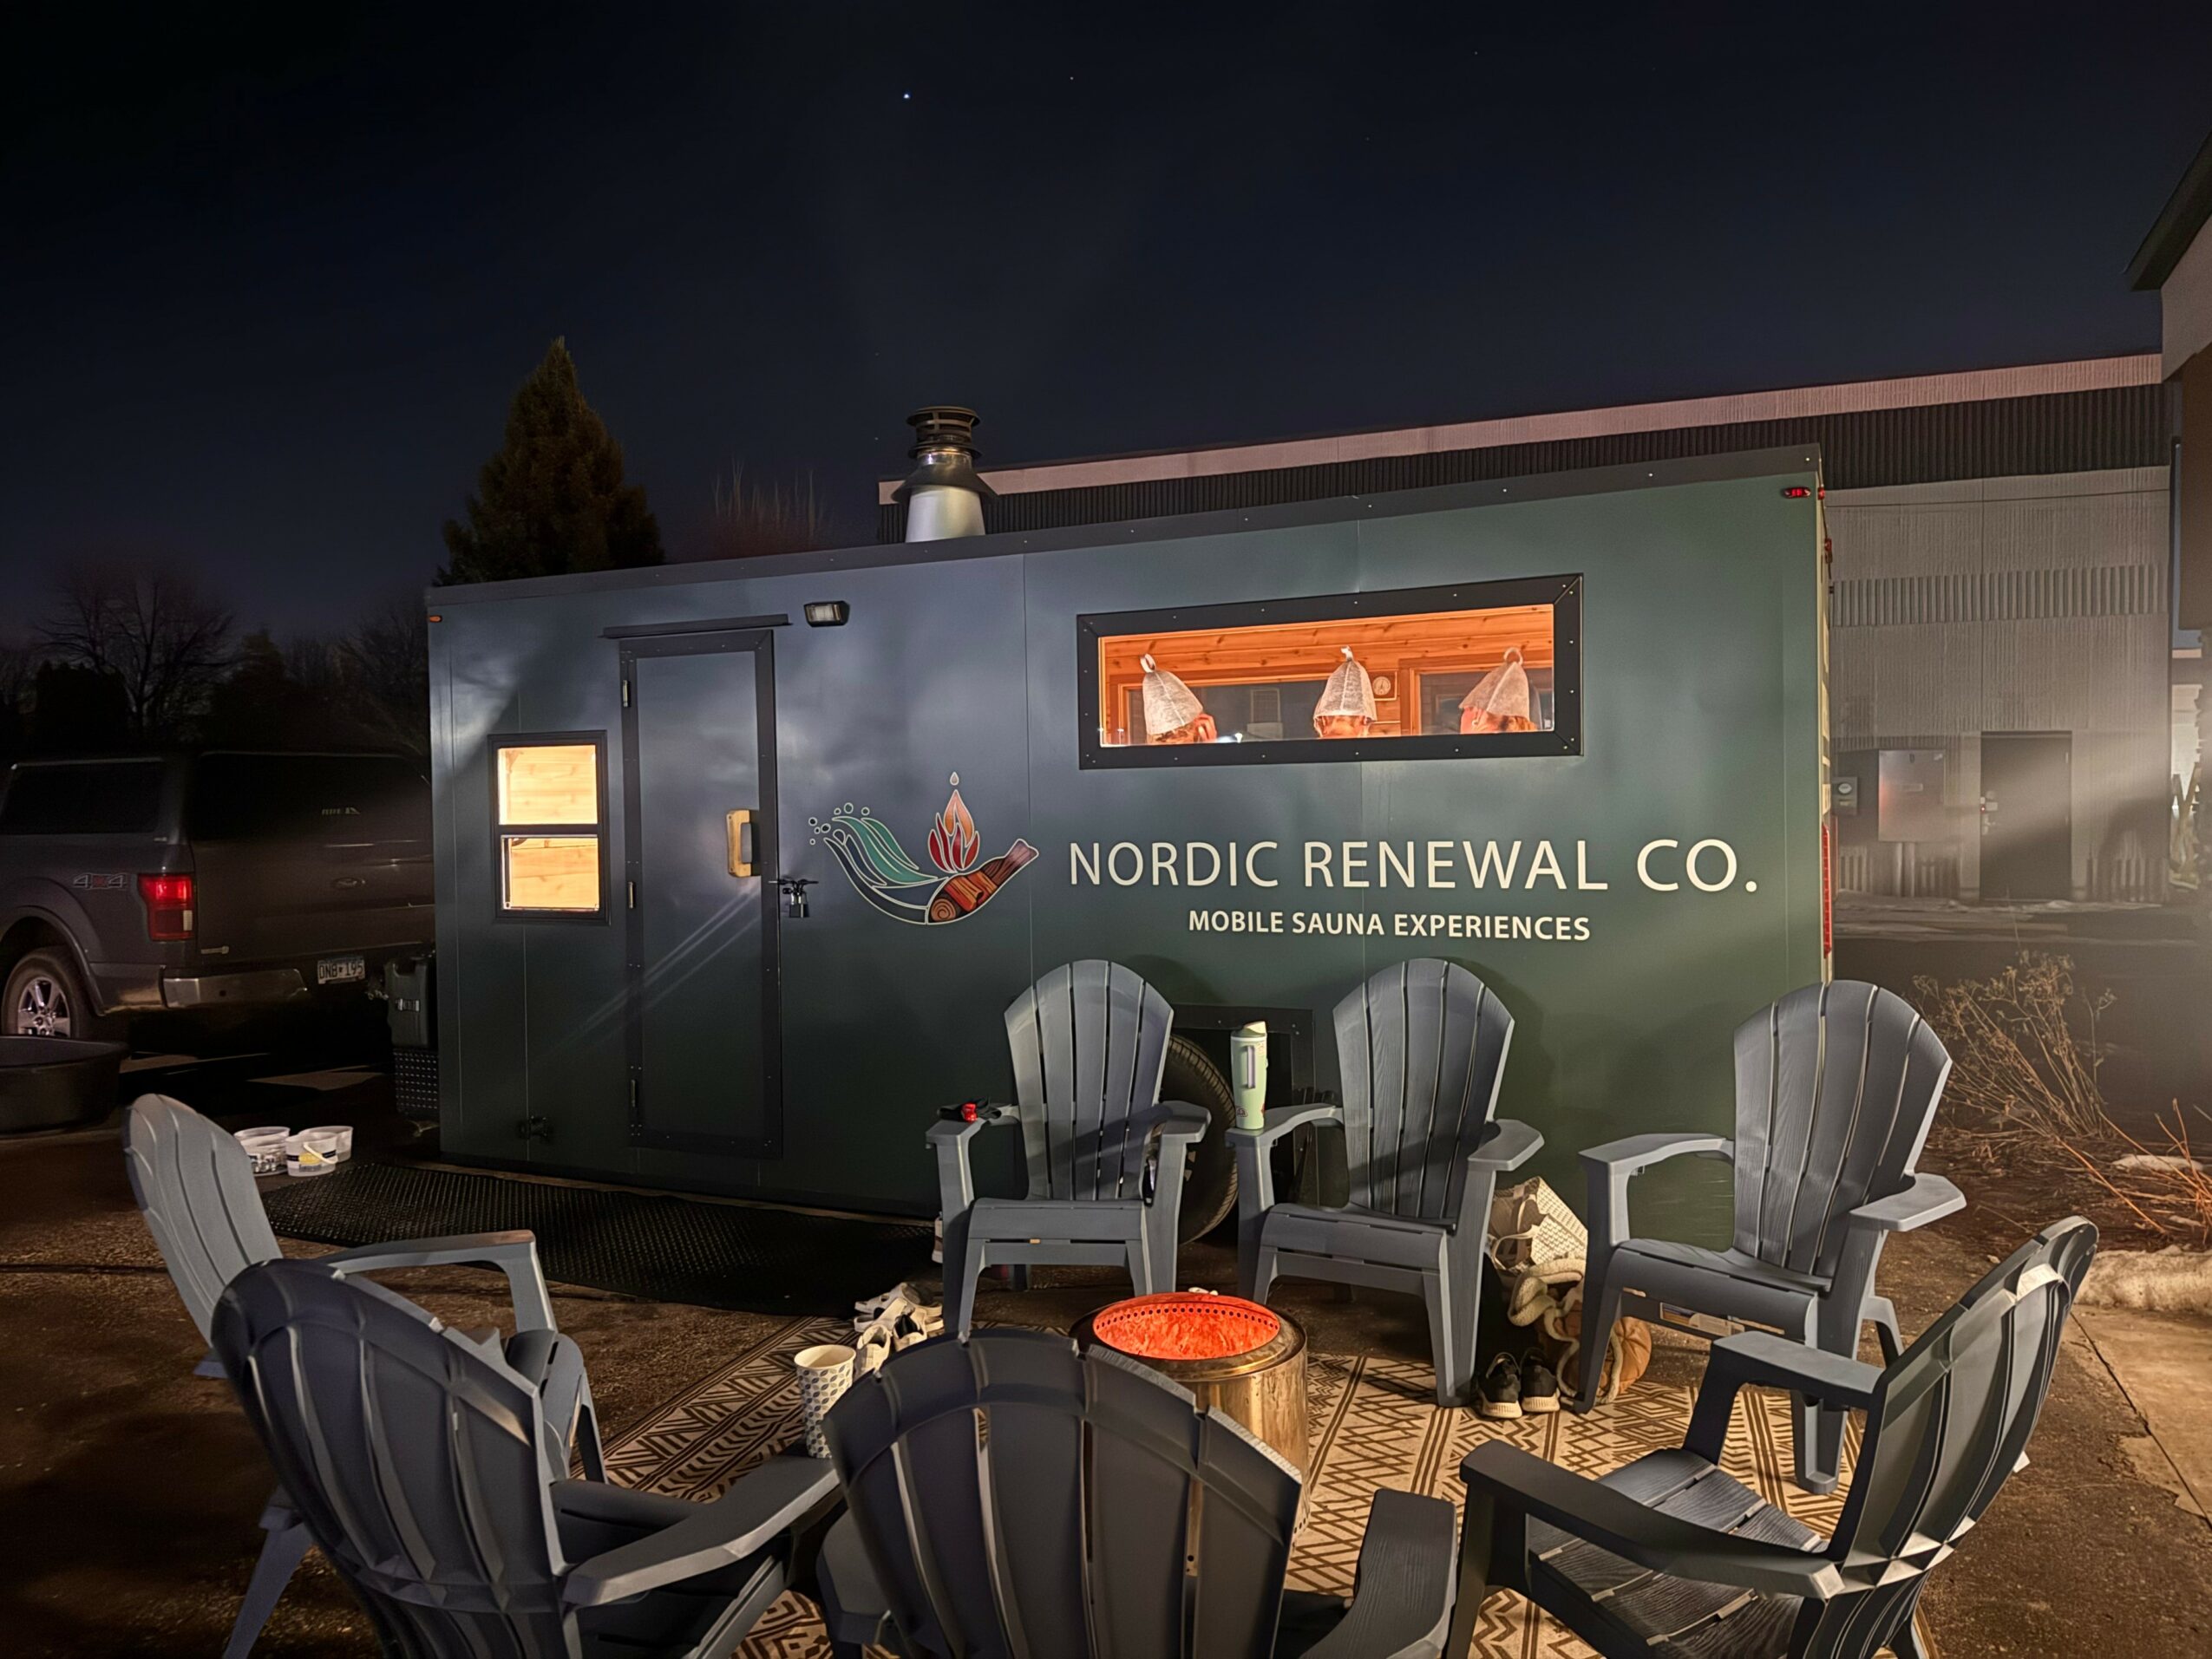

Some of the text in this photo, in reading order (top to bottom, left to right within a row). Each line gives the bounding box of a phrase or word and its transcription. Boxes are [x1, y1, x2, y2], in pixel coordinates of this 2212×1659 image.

[1070, 839, 1757, 892] NORDIC RENEWAL CO.
[1189, 910, 1590, 941] MOBILE SAUNA EXPERIENCES
